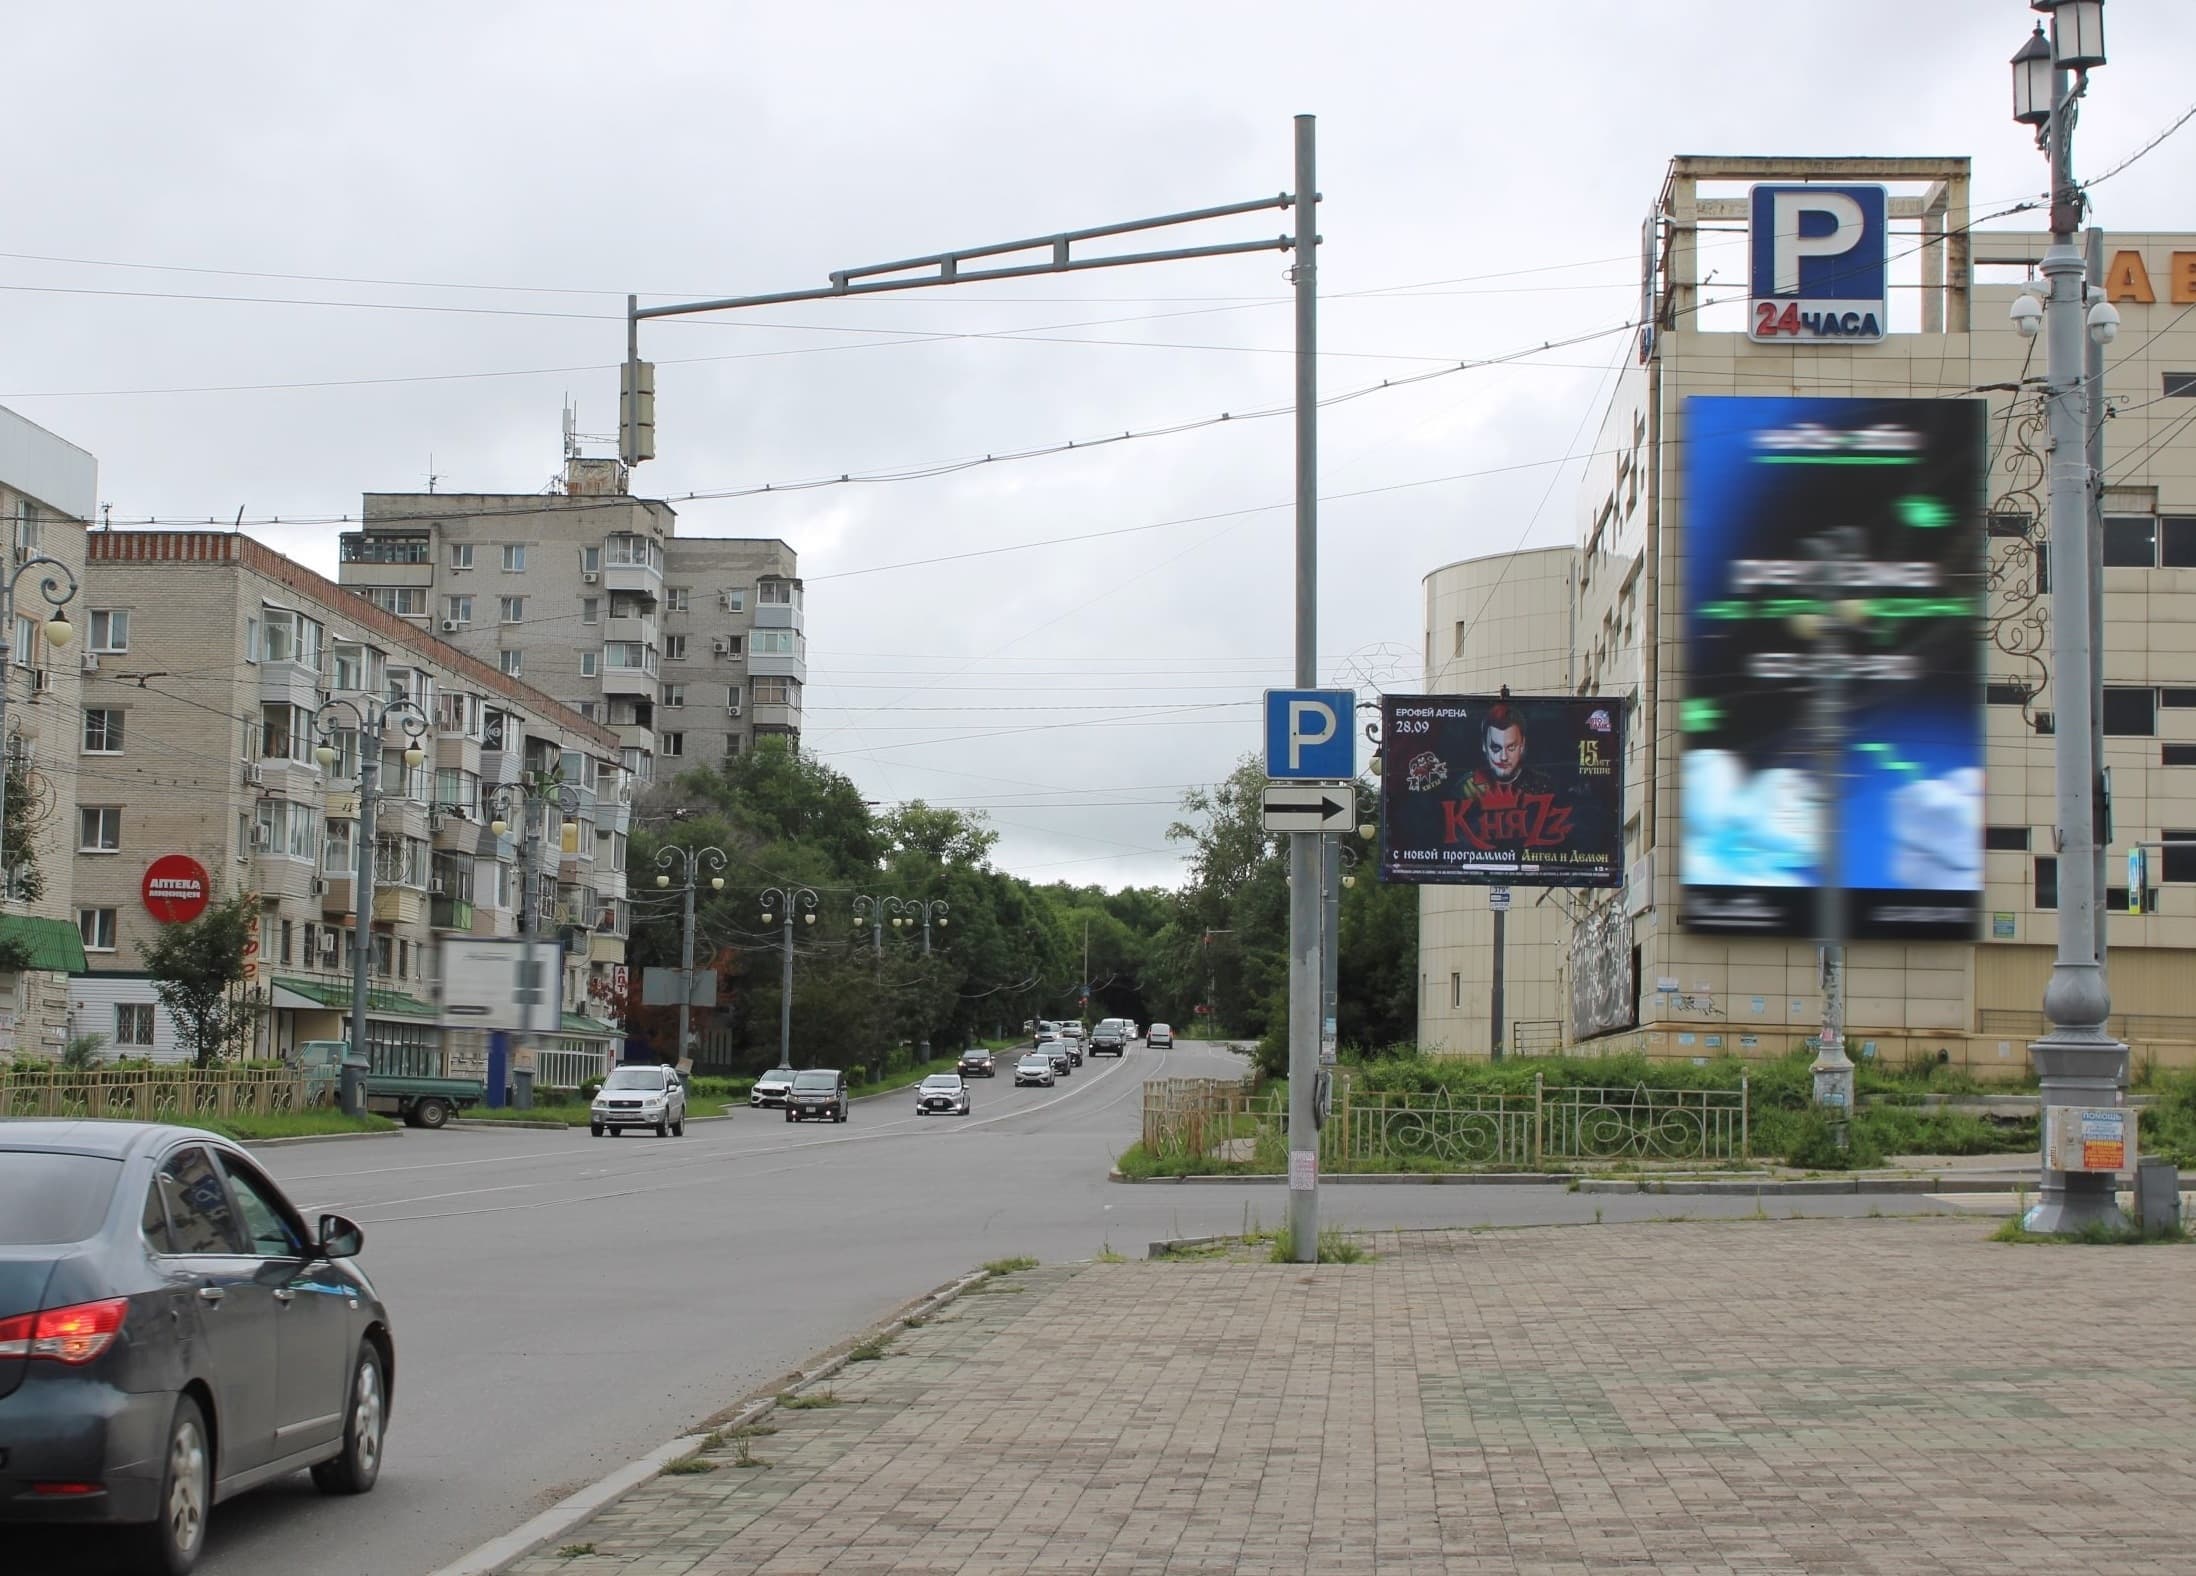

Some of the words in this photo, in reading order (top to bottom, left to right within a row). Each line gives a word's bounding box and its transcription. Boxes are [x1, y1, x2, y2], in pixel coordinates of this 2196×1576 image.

[1773, 192, 1864, 294] P
[1755, 302, 1801, 336] 24
[1801, 312, 1881, 336] ЧАСА
[1395, 707, 1434, 717] ЕРОФЕЙ
[1436, 708, 1467, 718] АРЕНА
[1289, 700, 1337, 769] P
[1395, 720, 1430, 733] 28.09
[1578, 740, 1599, 767] 15
[1403, 848, 1438, 860] новой
[1442, 849, 1516, 864] программой
[150, 878, 201, 889] АПТЕКА
